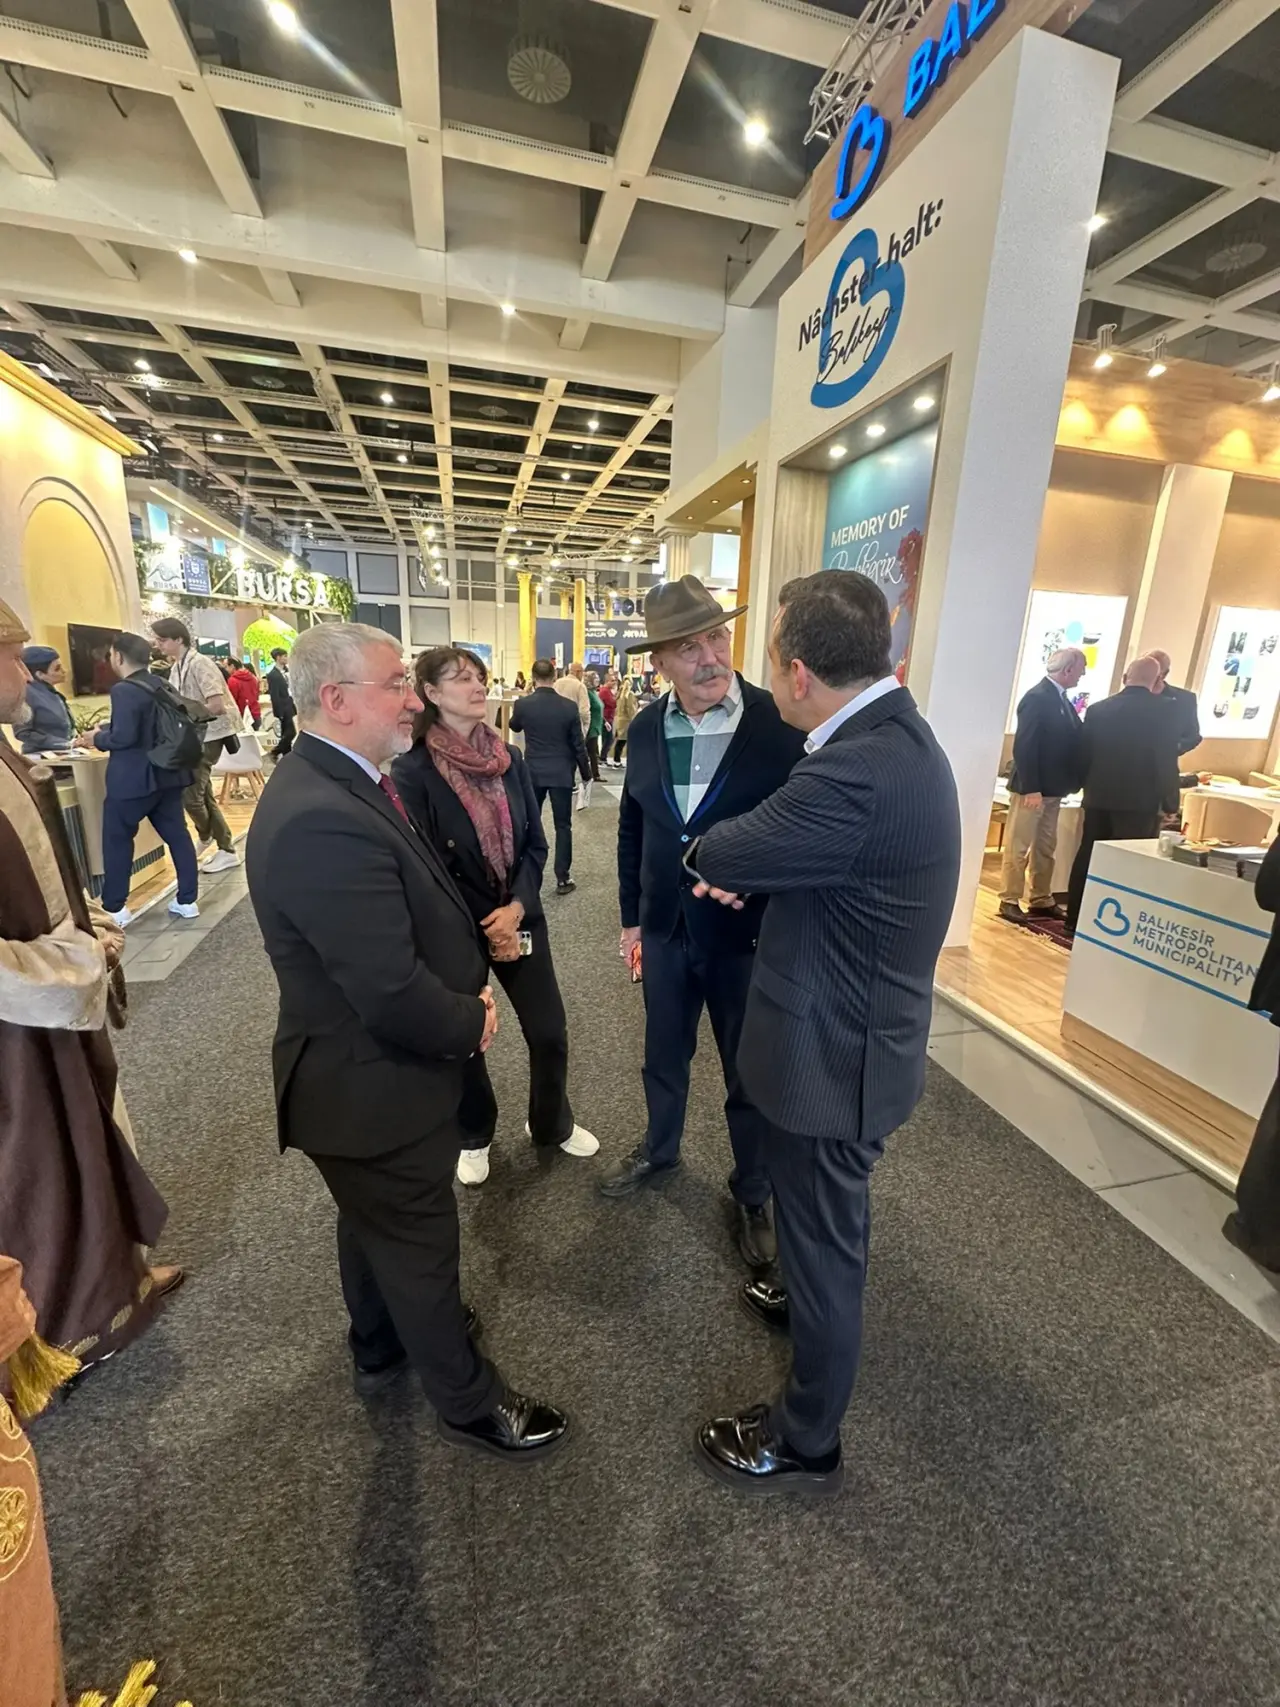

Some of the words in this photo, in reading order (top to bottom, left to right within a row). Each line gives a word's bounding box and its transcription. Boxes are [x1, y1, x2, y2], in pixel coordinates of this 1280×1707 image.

[886, 198, 943, 272] halt:
[831, 512, 887, 548] MEMORY
[889, 505, 910, 530] OF
[236, 568, 331, 608] BURSA
[1135, 922, 1260, 978] METROPOLITAN
[1138, 911, 1215, 948] BALIKESİR
[1133, 935, 1244, 986] MUNICIPALITY
